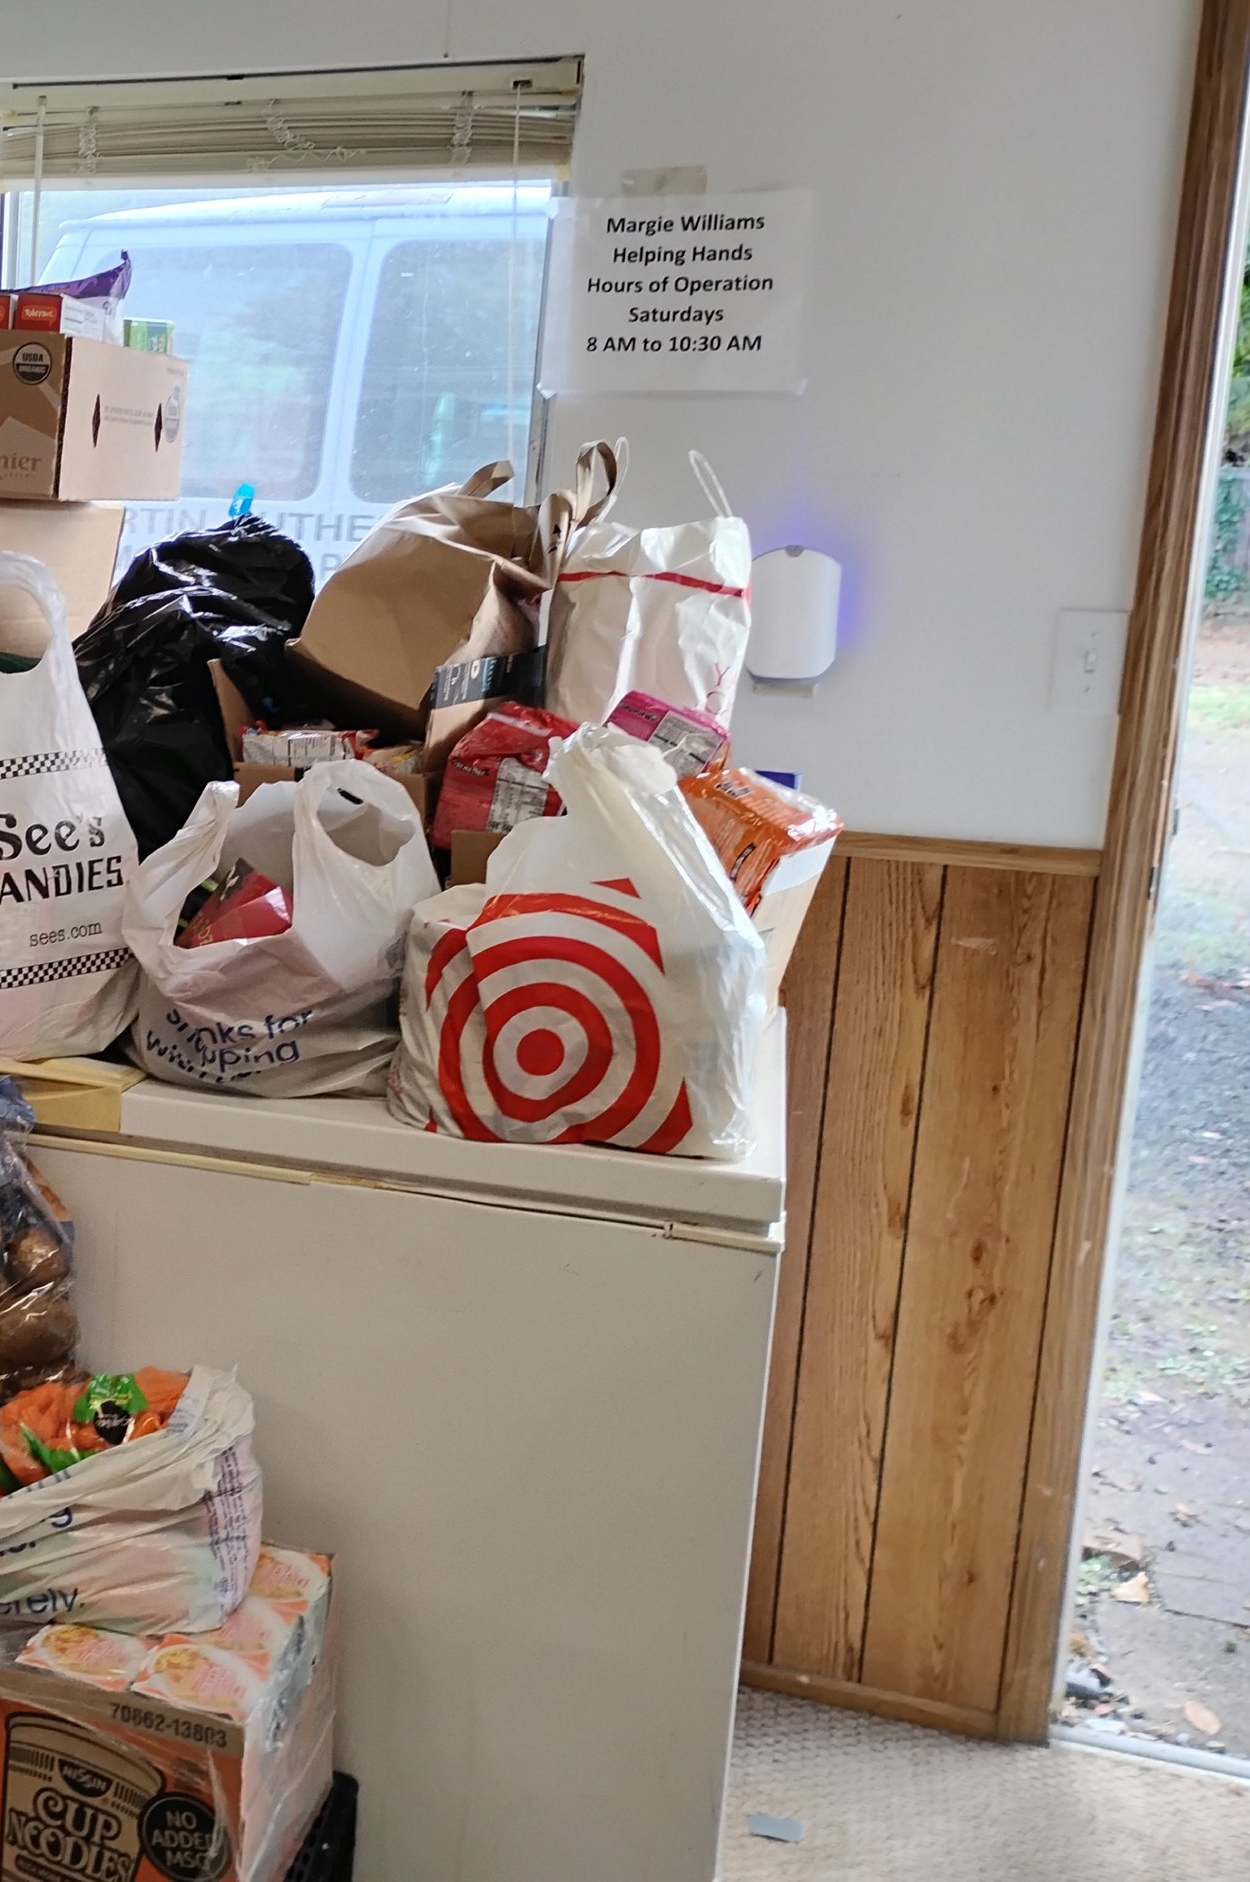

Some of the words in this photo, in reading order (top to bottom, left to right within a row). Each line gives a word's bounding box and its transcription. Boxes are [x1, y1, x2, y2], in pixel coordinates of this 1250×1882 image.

[606, 216, 674, 236] Margie
[681, 214, 765, 231] Williams
[613, 246, 686, 267] Helping
[692, 244, 753, 262] Hands
[587, 278, 643, 293] Hours
[649, 276, 669, 293] of
[674, 275, 773, 296] Operation
[628, 306, 724, 326] Saturdays
[586, 336, 598, 352] 8
[603, 337, 636, 352] AM
[643, 337, 662, 352] to
[669, 335, 721, 352] 10:30
[726, 335, 762, 351] AM
[22, 353, 44, 362] USDA
[29, 922, 103, 948] sees.com
[264, 1010, 313, 1039] for
[62, 1765, 108, 1792] NISSIN
[33, 1788, 122, 1844] CUP
[166, 1810, 197, 1830] NO
[4, 1807, 136, 1882] NOODLES
[151, 1830, 222, 1850] ADDED
[166, 1852, 211, 1871] MSG
